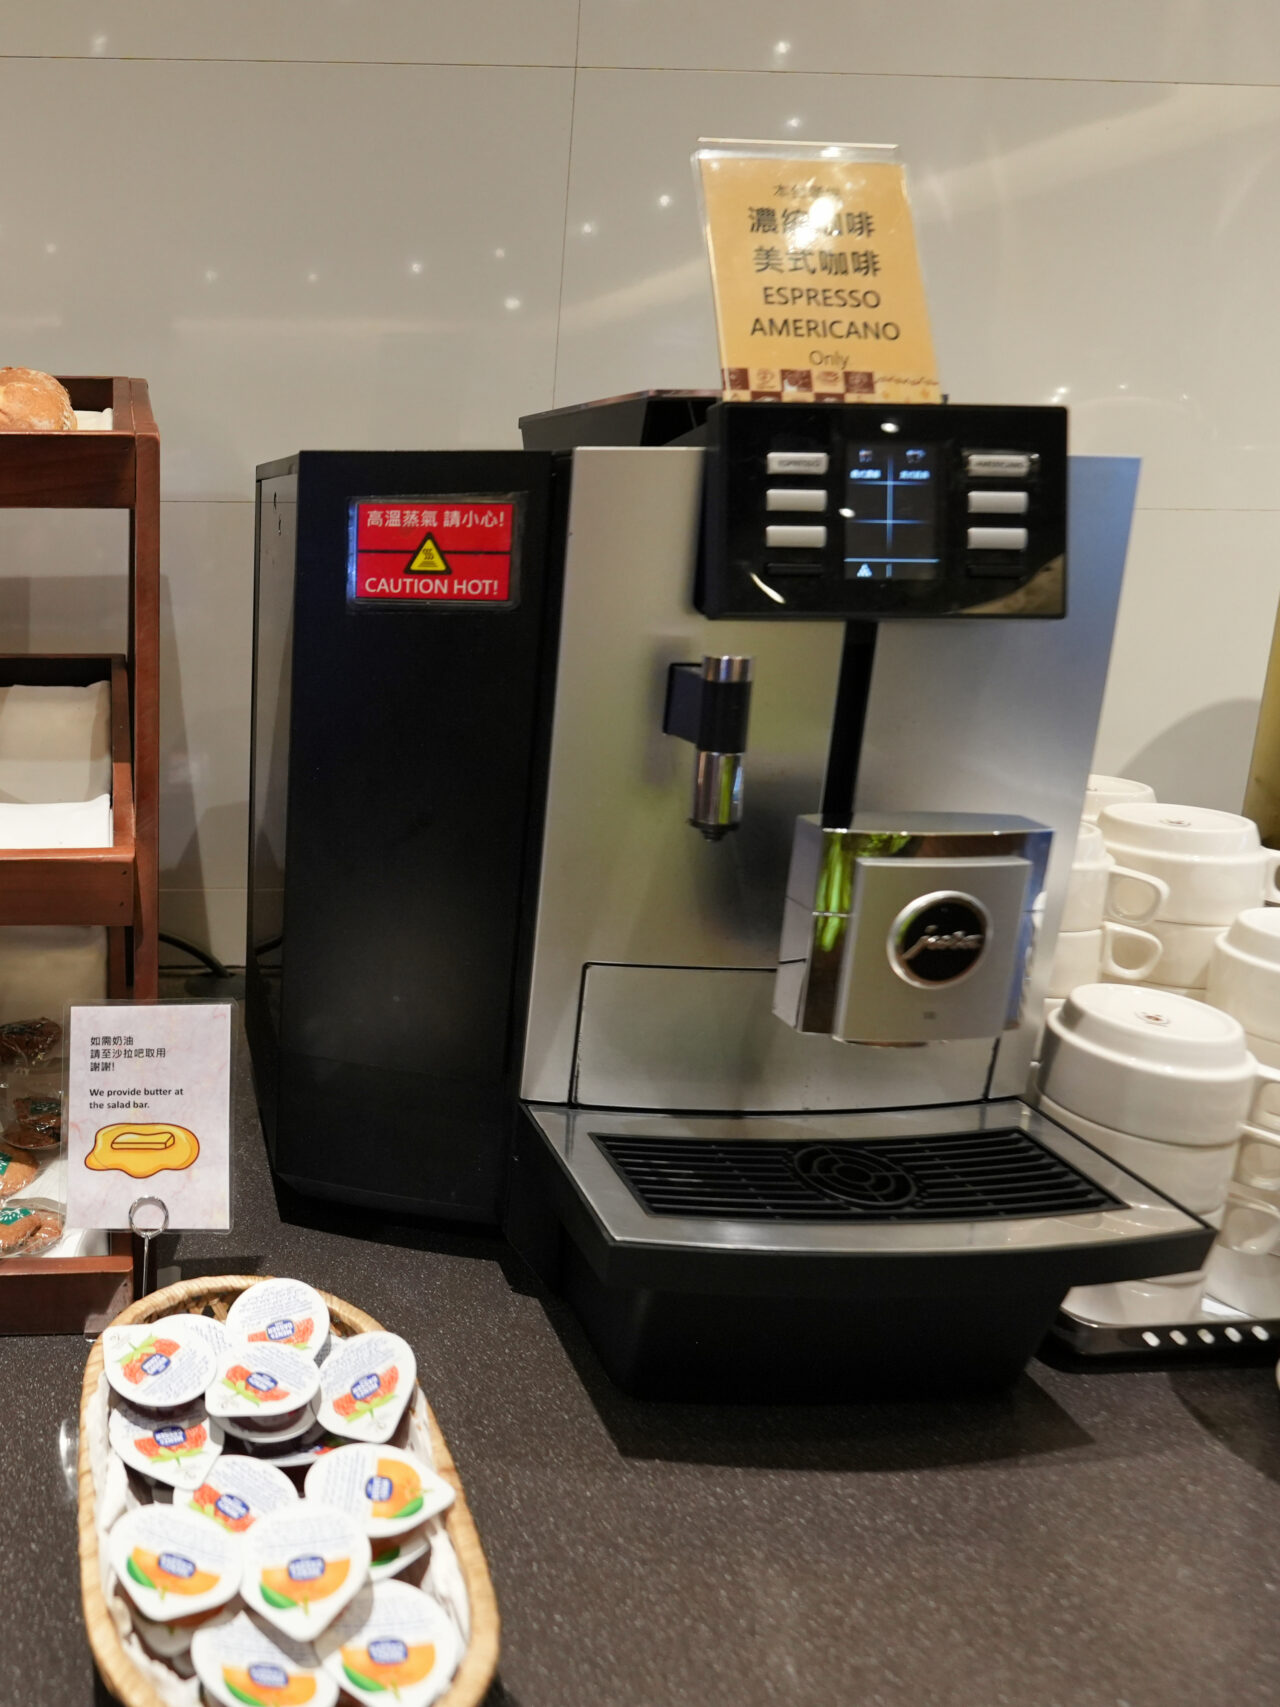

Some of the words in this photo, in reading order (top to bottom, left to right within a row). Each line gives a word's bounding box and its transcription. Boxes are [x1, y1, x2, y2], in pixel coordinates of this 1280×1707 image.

[753, 246, 881, 277] 美式咖啡
[763, 286, 881, 309] ESPRESSO
[750, 317, 901, 341] AMERICANO
[809, 350, 850, 369] Only
[367, 510, 438, 528] 高溫蒸氣
[443, 510, 505, 528] 請小心!
[365, 577, 448, 594] CAUTION
[454, 579, 498, 595] HOT!
[90, 1036, 134, 1046] 如需奶油
[90, 1047, 166, 1059] 請至沙拉吧取用
[90, 1061, 115, 1072] 謝謝!
[107, 1088, 142, 1098] provide
[144, 1088, 172, 1096] butter
[174, 1088, 184, 1096] at
[89, 1101, 104, 1109] the
[107, 1101, 131, 1109] salad
[133, 1101, 150, 1109] bar.
